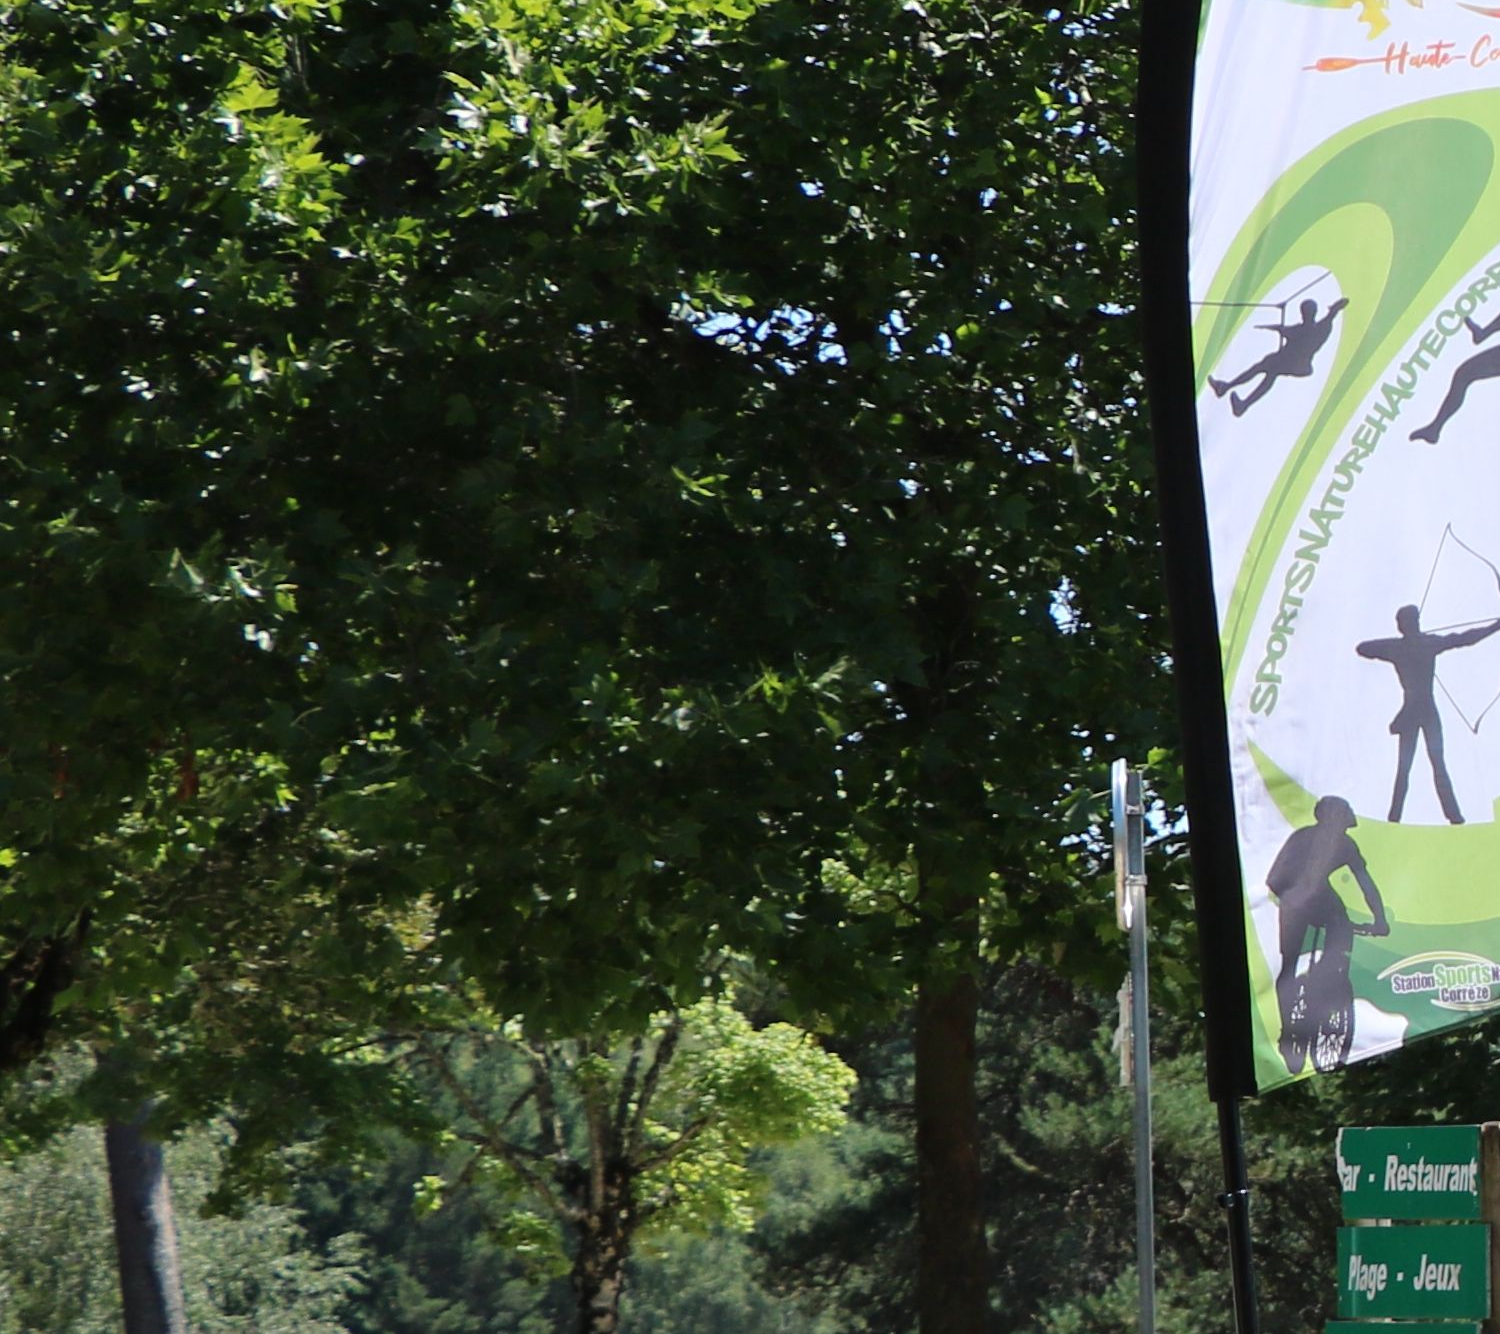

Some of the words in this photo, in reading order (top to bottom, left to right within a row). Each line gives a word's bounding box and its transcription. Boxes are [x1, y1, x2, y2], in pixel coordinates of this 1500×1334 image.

[1384, 1155, 1478, 1194] Restaurant
[1348, 1255, 1388, 1301] Plage
[1413, 1253, 1462, 1291] Jeux
